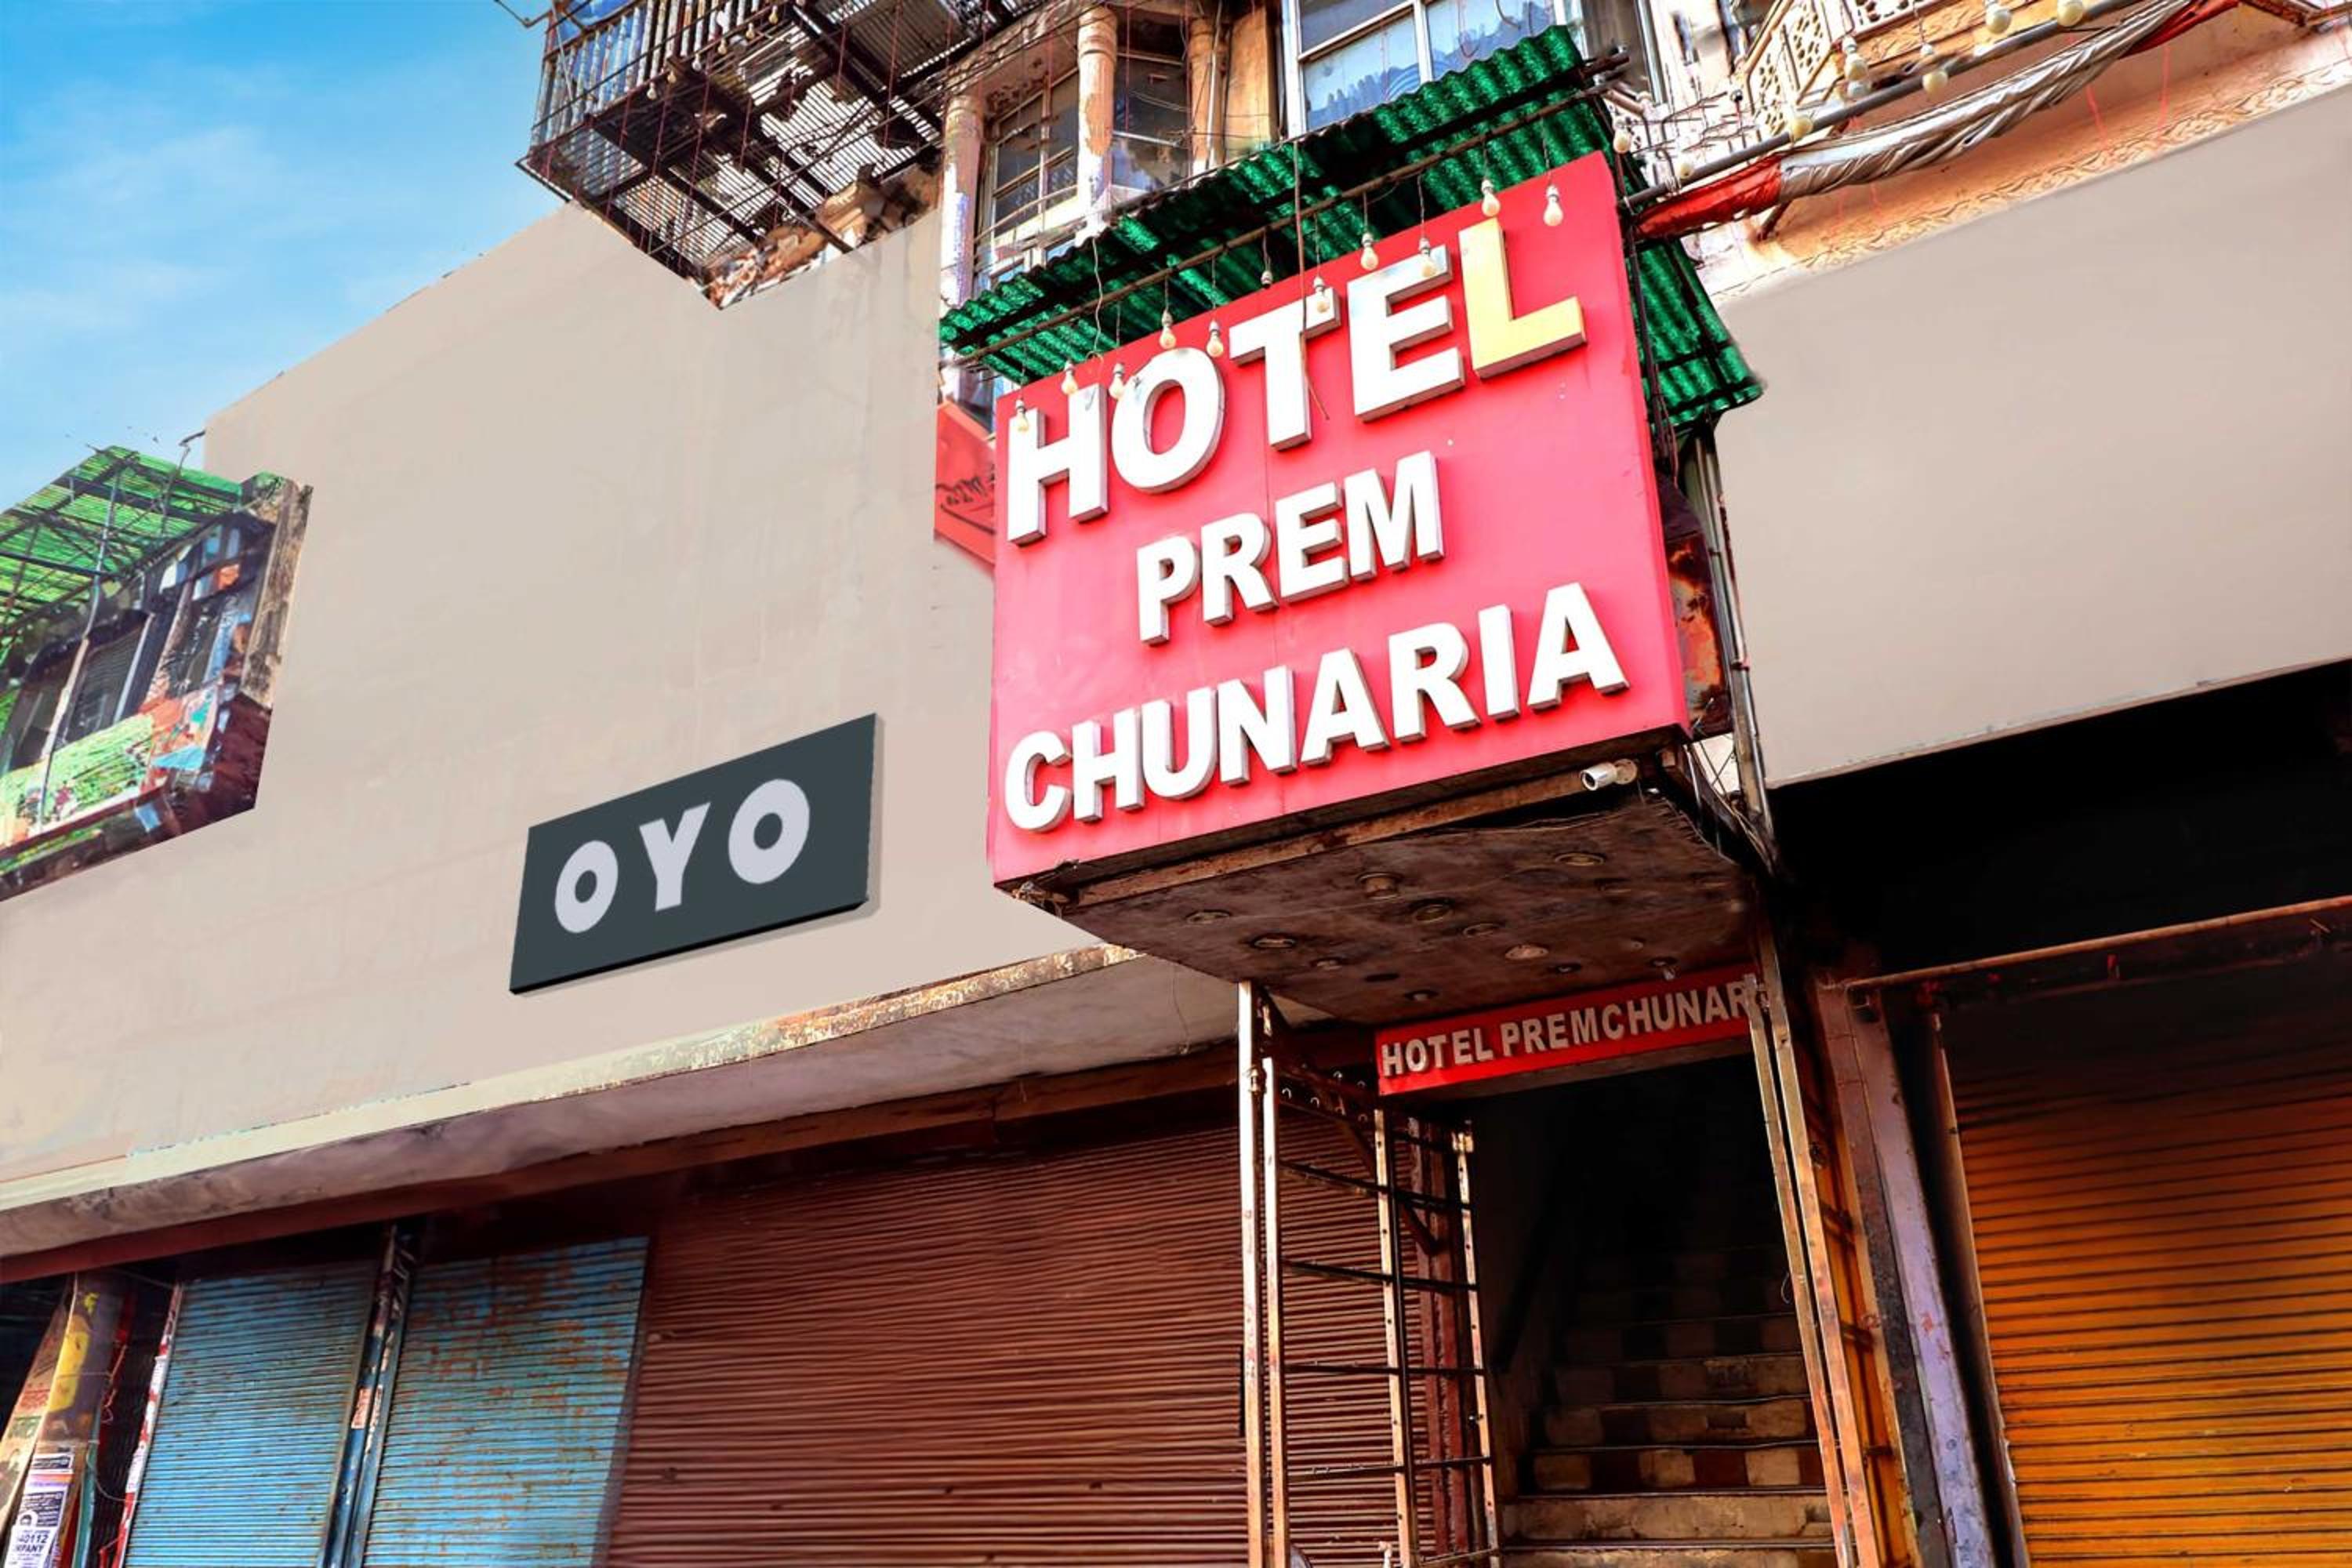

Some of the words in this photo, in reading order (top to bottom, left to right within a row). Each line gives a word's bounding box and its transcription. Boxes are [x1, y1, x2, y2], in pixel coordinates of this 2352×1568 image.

[1006, 218, 1588, 548] HOTEL
[1135, 450, 1445, 646] PREM
[1004, 583, 1631, 834] CHUNARIA
[554, 778, 810, 934] OYO
[1380, 1026, 1494, 1077] HOTEL
[1500, 979, 1751, 1058] PREMCHUNAR
